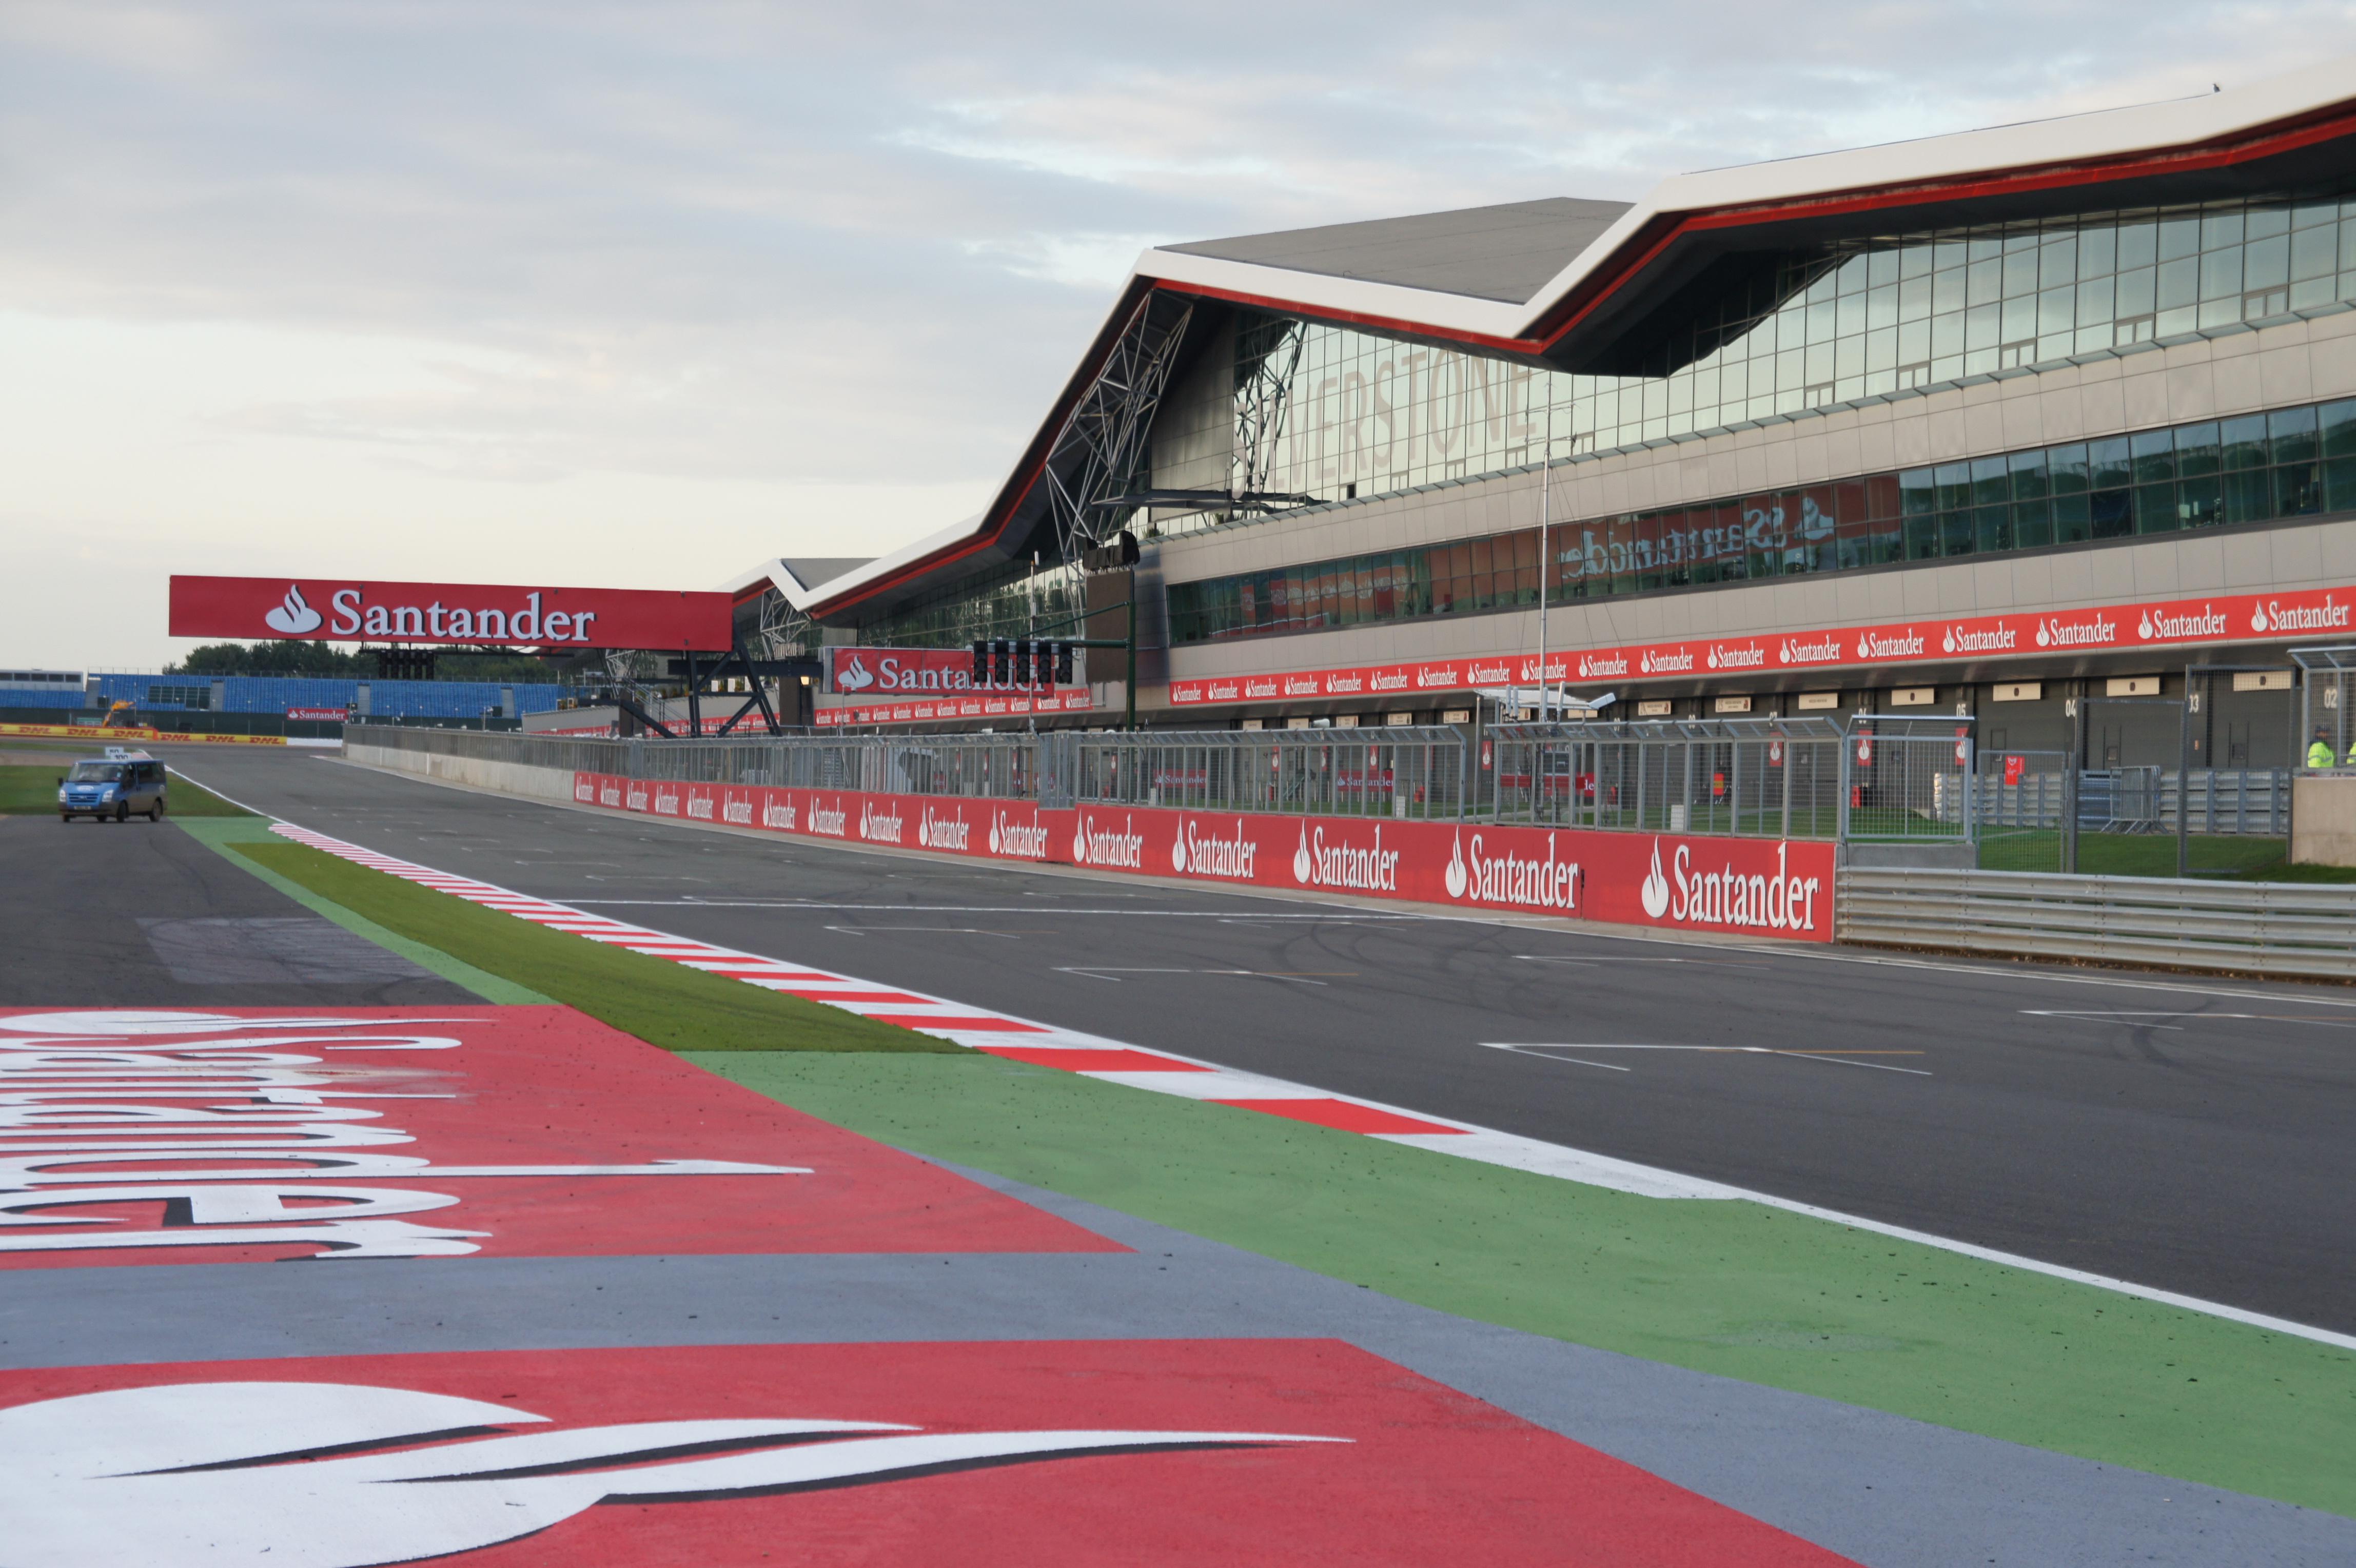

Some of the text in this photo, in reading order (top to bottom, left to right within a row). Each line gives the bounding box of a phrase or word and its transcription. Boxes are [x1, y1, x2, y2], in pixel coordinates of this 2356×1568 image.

[331, 590, 594, 641] Santander
[2154, 604, 2225, 639] Santander
[2268, 594, 2348, 631] Santander
[1870, 629, 1923, 657] Santander
[1956, 621, 2015, 652] Santander
[2050, 613, 2115, 645] Santander
[1650, 646, 1693, 672] Santander
[1717, 641, 1764, 668] Santander
[1791, 635, 1840, 663] Santander
[1376, 668, 1407, 689] Santander
[1424, 664, 1457, 687] Santander
[1475, 661, 1509, 683] Santander
[1587, 652, 1627, 677] Santander
[1177, 684, 1201, 701] Santander
[1213, 681, 1238, 700] Santander
[1250, 678, 1276, 697] Santander
[1290, 675, 1317, 695] Santander
[1332, 672, 1361, 692] Santander
[1069, 692, 1089, 708] Santander
[1956, 703, 1966, 718] 05
[2065, 699, 2076, 717] 04
[2324, 689, 2338, 709] 02
[300, 710, 345, 719] Santander
[249, 736, 281, 744] DHL
[630, 781, 647, 811] Santander
[659, 784, 678, 815] Santander
[692, 787, 713, 819] Santander
[728, 790, 752, 824] Santander
[770, 793, 796, 830] Santander
[815, 797, 846, 836] Santander
[868, 800, 902, 843] Santander
[928, 805, 969, 851] Santander
[999, 809, 1047, 858] Santander
[1086, 814, 1142, 868] Santander
[1187, 818, 1256, 878] Santander
[1312, 824, 1398, 891] Santander
[1469, 832, 1579, 909] Santander
[1673, 842, 1818, 931] Santander
